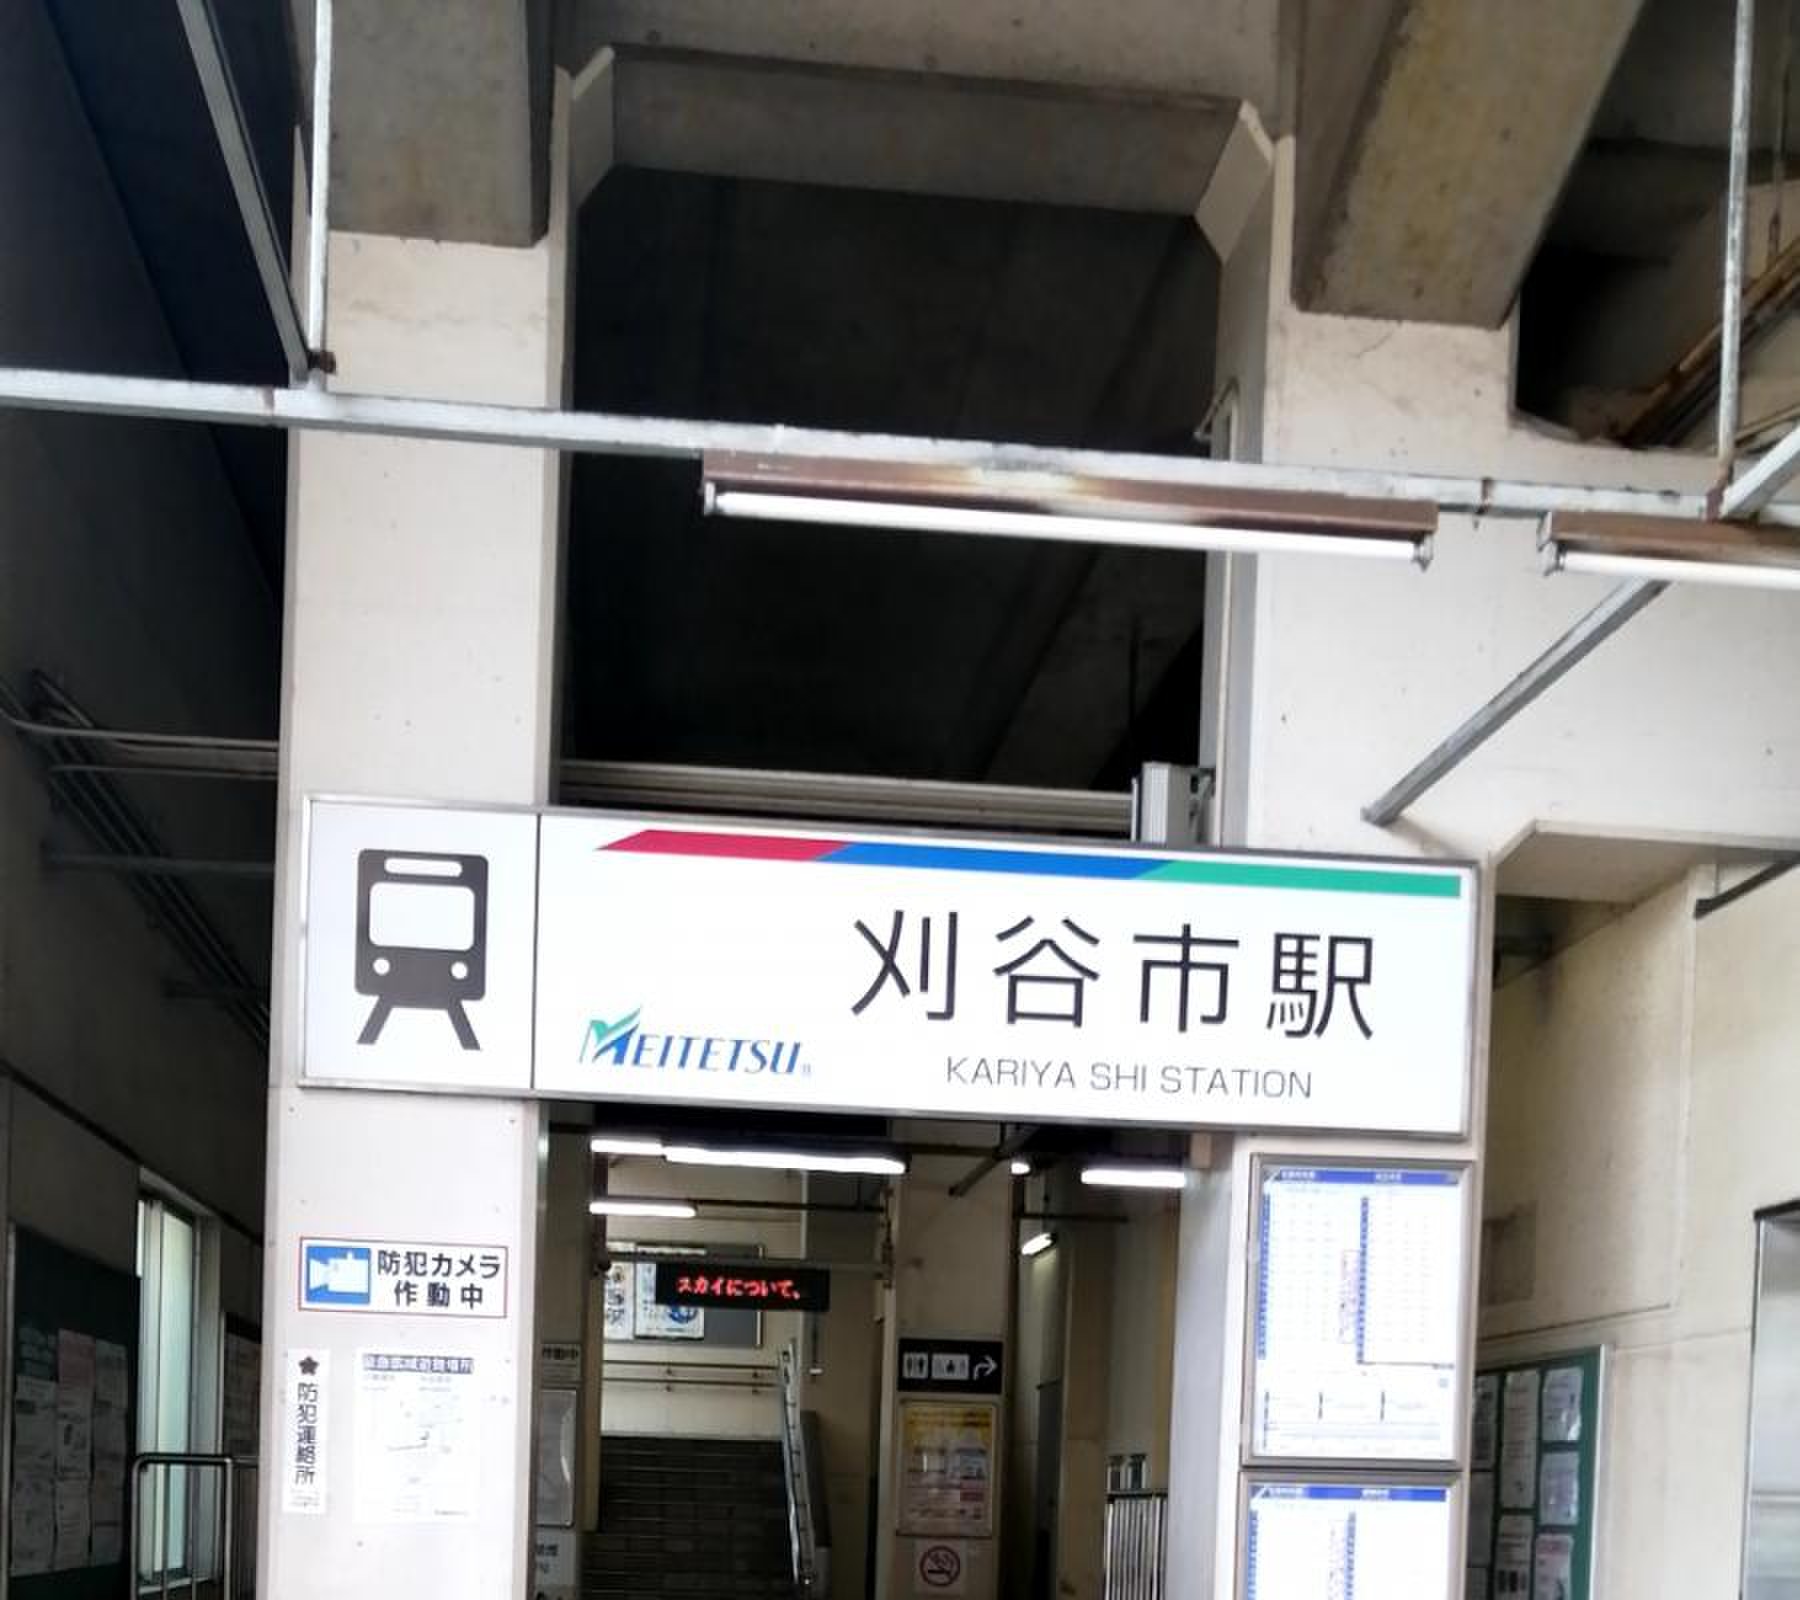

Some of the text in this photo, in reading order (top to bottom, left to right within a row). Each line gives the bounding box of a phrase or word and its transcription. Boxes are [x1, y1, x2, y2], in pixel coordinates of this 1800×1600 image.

[851, 909, 1373, 1040] 刈谷市駅
[579, 1004, 803, 1074] MEITETSU
[946, 1056, 1312, 1099] KARIYA SHI STATION
[377, 1249, 501, 1280] 防犯カメラ
[394, 1279, 484, 1310] 作動中
[295, 1382, 319, 1485] 防犯連絡所
